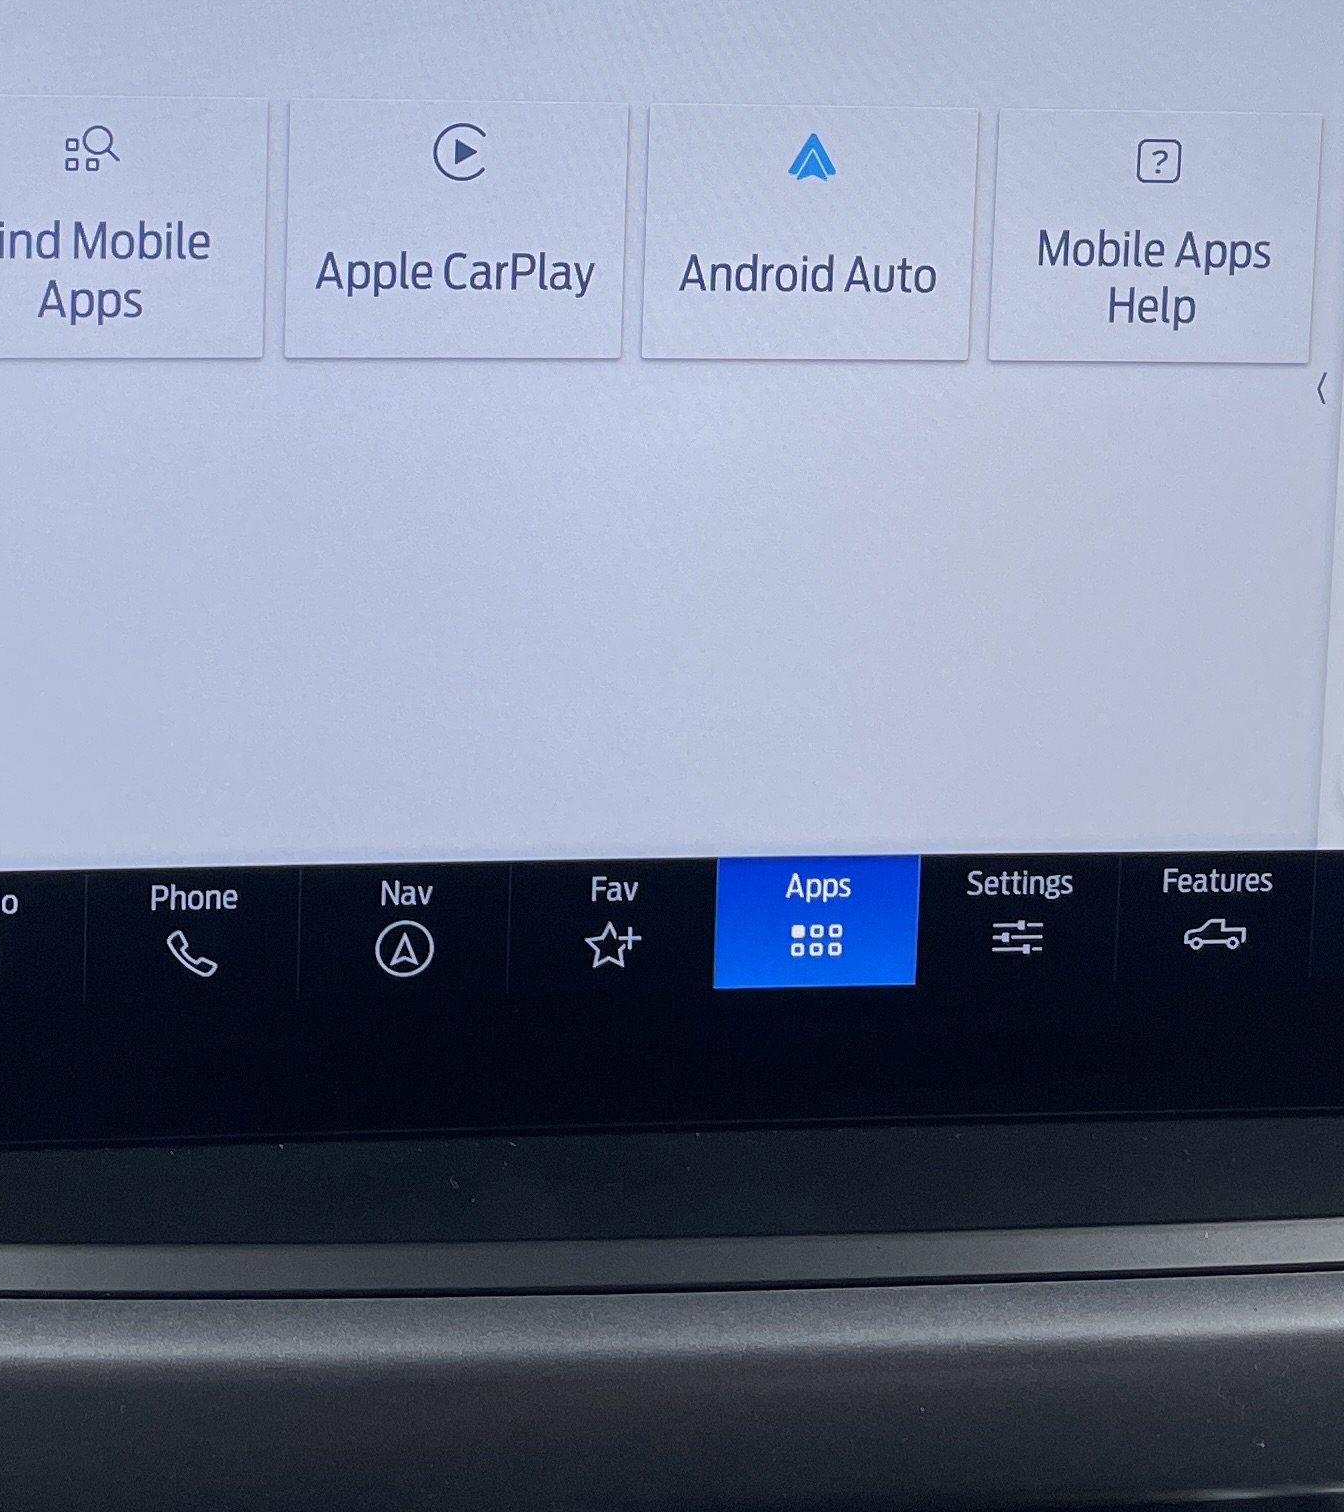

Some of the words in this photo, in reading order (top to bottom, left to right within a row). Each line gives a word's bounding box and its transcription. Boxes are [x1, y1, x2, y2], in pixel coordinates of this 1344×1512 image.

[73, 220, 211, 260] Mobile
[1038, 228, 1165, 268] Mobile
[1174, 231, 1271, 276] Apps
[315, 250, 433, 298] Apple
[443, 251, 596, 299] CarPlay
[679, 253, 834, 293] Android
[843, 255, 937, 294] Auto
[37, 280, 143, 326] Apps
[1108, 286, 1197, 332] Help
[150, 883, 239, 911] Phone
[380, 879, 434, 907] Nav
[590, 875, 640, 902] Fav
[785, 872, 853, 904] Apps
[966, 869, 1074, 900] Settings
[1161, 867, 1274, 894] Features
